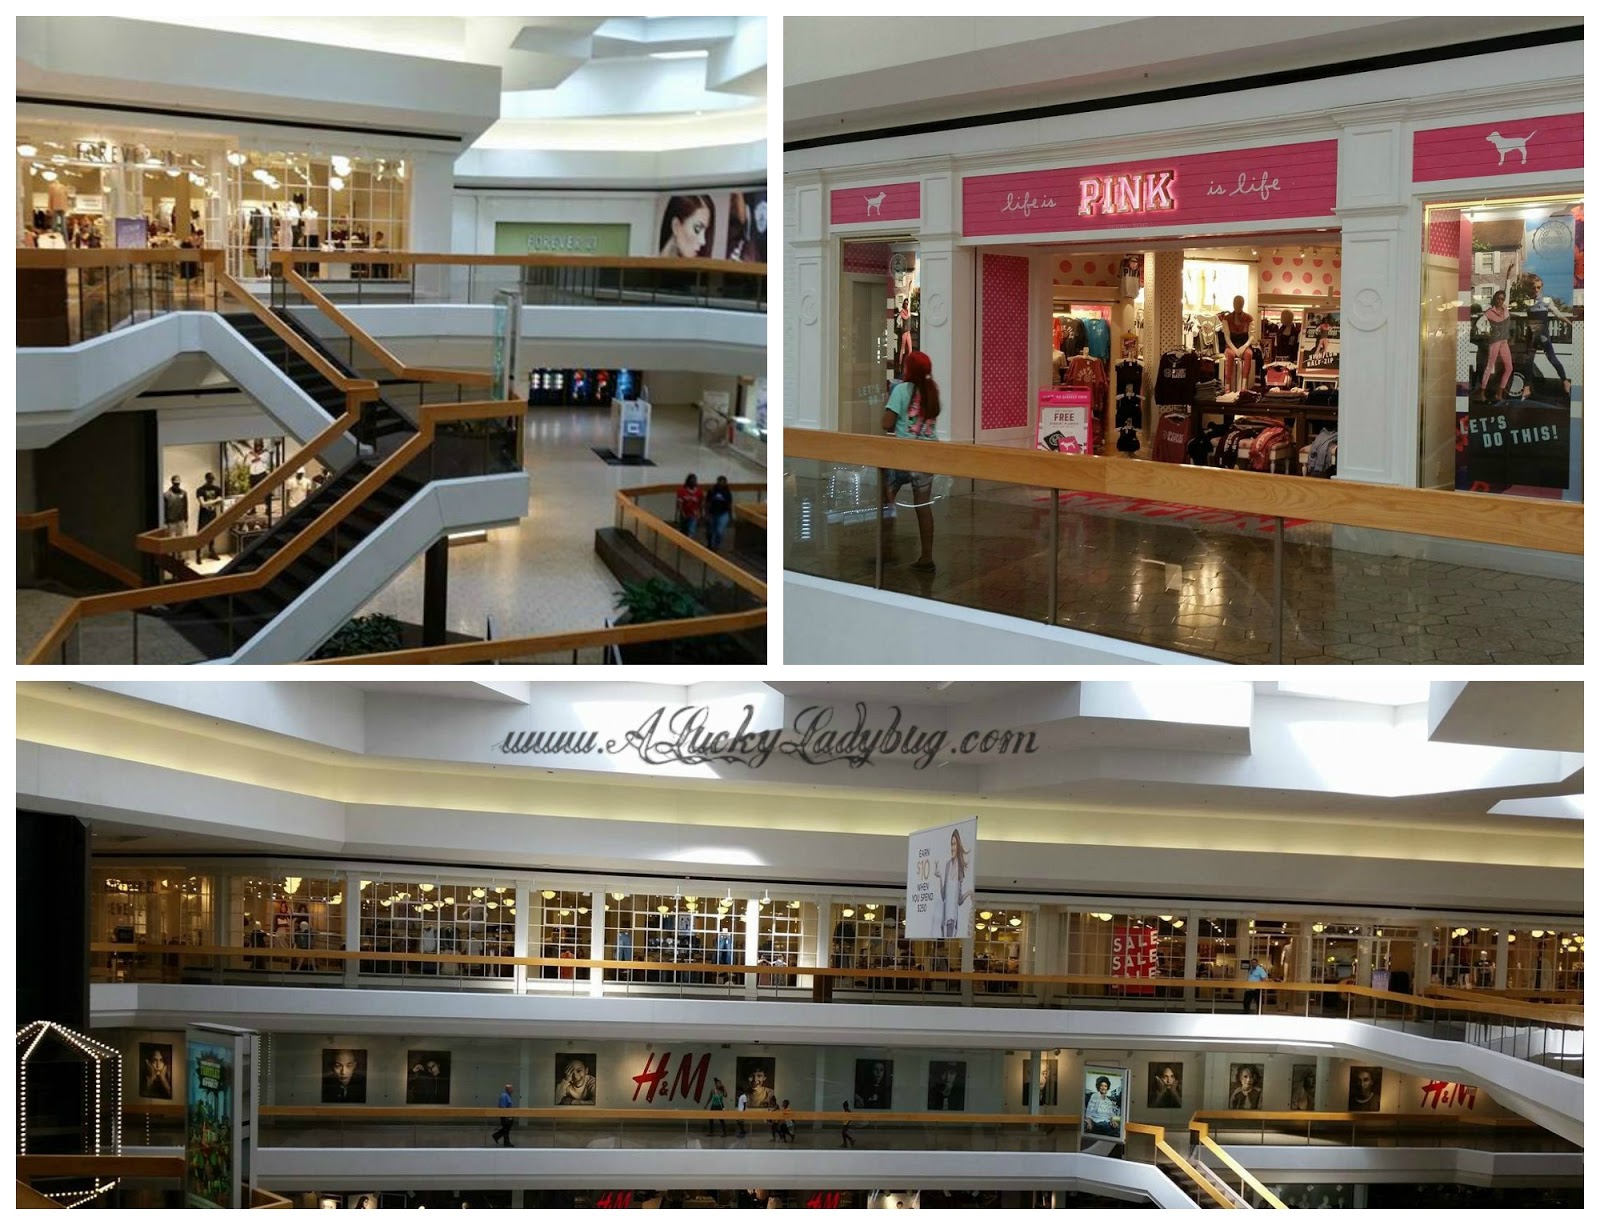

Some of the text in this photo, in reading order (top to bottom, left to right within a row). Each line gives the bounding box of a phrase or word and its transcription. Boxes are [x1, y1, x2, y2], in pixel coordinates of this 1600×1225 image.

[1078, 169, 1175, 216] PINK
[1207, 170, 1281, 200] is life
[1001, 192, 1056, 217] life is
[1054, 413, 1075, 422] FREE
[1460, 415, 1507, 435] LET'S
[1482, 424, 1558, 448] DO THIS!
[919, 848, 930, 858] EARN
[912, 893, 934, 902] YOU SPEND
[917, 883, 929, 892] WHEN
[1113, 930, 1158, 952] SALE
[1112, 948, 1157, 971] SALE
[632, 1051, 712, 1103] H&M
[1421, 1080, 1478, 1111] H&M
[596, 1190, 632, 1208] HM
[806, 1190, 840, 1208] HM
